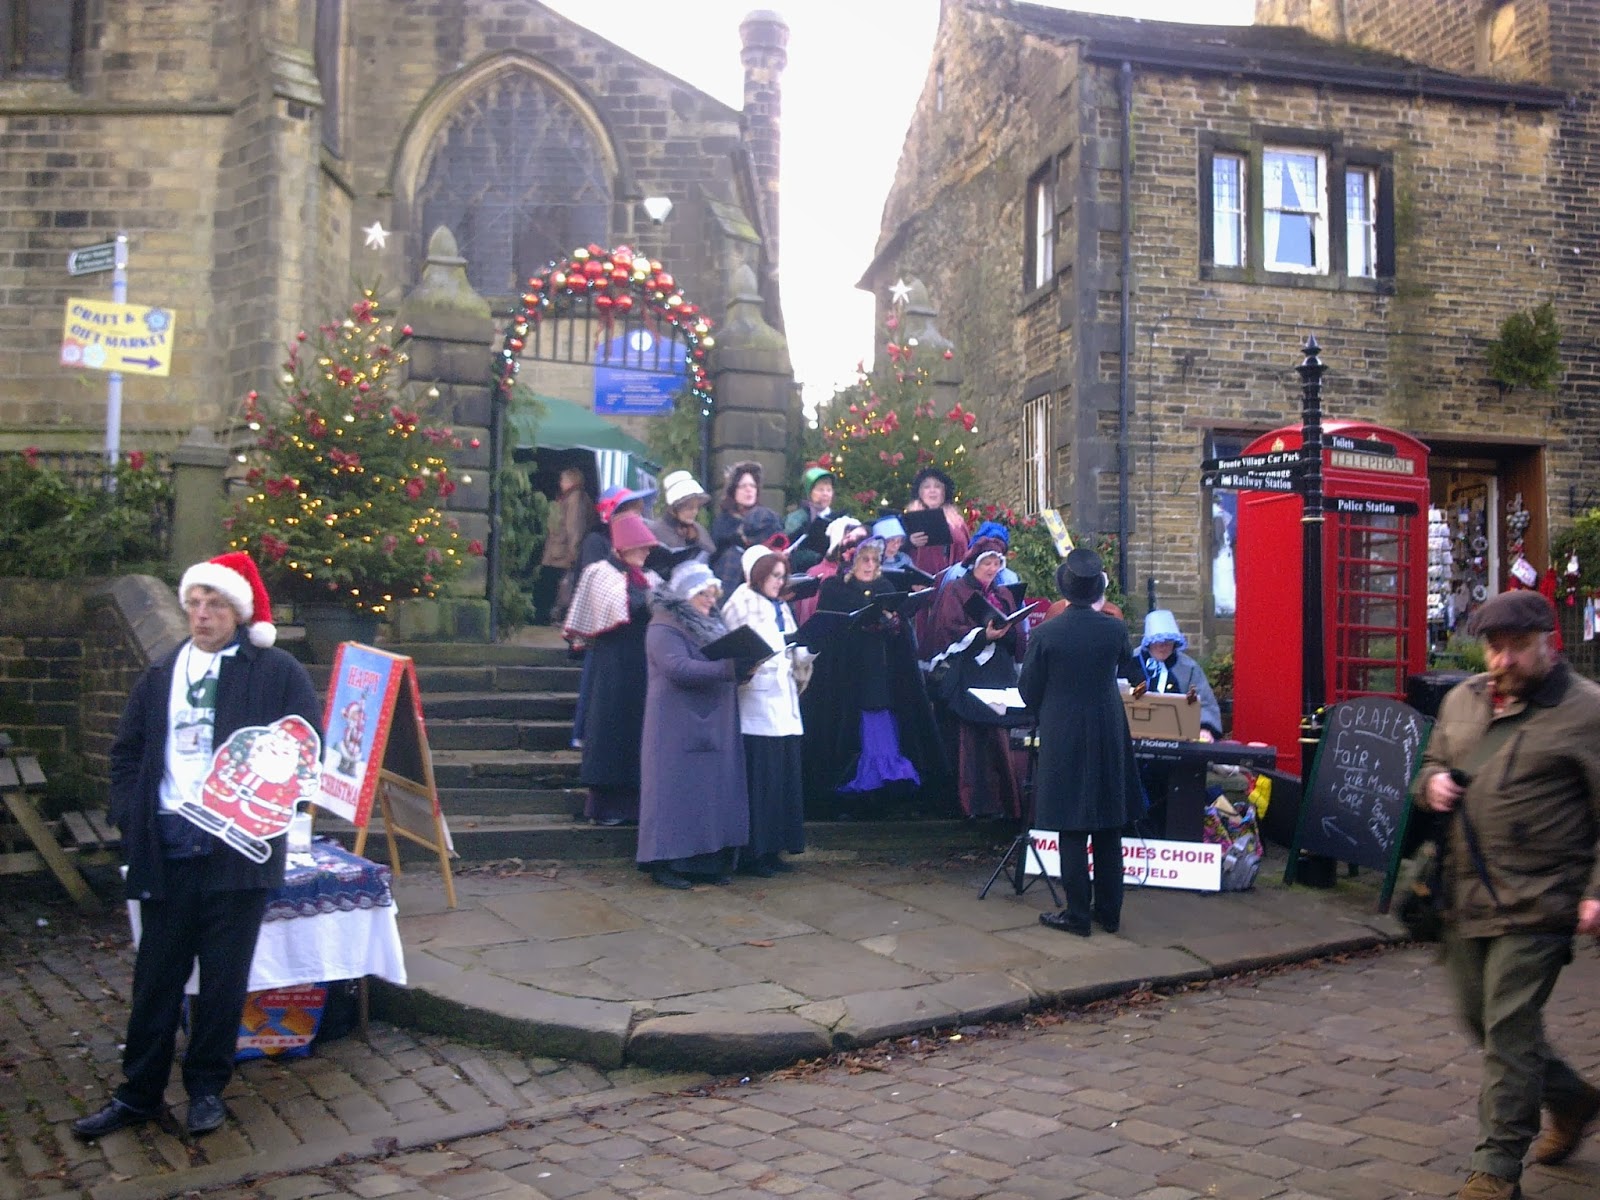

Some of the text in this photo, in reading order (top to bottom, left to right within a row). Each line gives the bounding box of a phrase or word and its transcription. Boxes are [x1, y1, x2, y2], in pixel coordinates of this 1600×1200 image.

[105, 334, 166, 348] MARKET
[1332, 436, 1355, 449] Toilets
[1218, 451, 1300, 470] Bronte Village Car Park
[1335, 452, 1410, 472] TELEPHONE
[1232, 474, 1292, 490] Railway Station
[1338, 499, 1395, 514] Police Station
[348, 666, 381, 692] HAPPY
[1140, 739, 1179, 749] Roland
[320, 773, 358, 806] CHRISTMA
[1121, 846, 1157, 860] DIES
[1160, 848, 1215, 864] CHOIR
